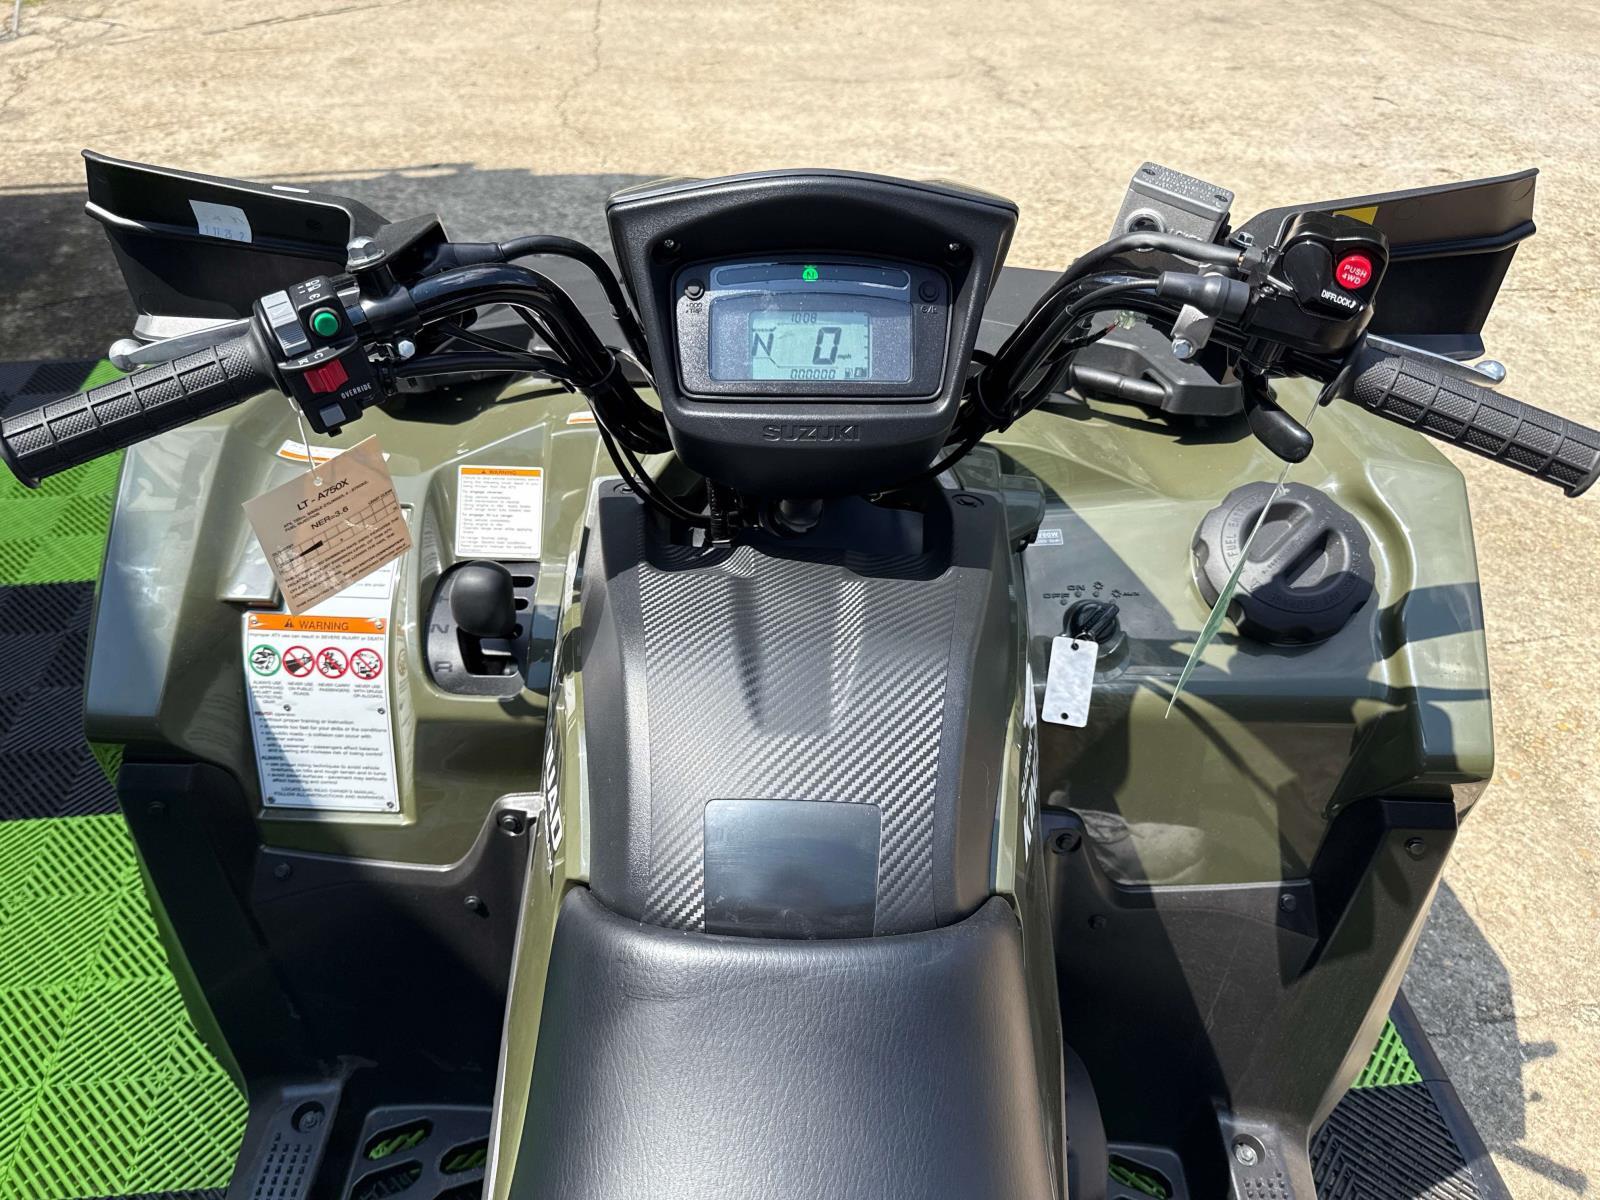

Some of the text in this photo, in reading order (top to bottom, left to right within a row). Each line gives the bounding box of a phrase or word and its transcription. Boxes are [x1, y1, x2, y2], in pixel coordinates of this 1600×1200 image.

[1341, 273, 1361, 285] 4WD
[1344, 264, 1368, 277] PUSH
[1321, 289, 1350, 308] DIFFLOCK
[752, 332, 774, 356] N
[812, 327, 842, 365] 0
[790, 369, 836, 379] 000000
[341, 382, 373, 400] OVERRIDE
[762, 424, 861, 441] SUZUKI
[297, 499, 308, 511] LT
[318, 478, 349, 500] A750X
[1228, 534, 1239, 557] FUEL
[299, 621, 349, 631] WARNING
[430, 624, 450, 634] N
[435, 661, 453, 672] R
